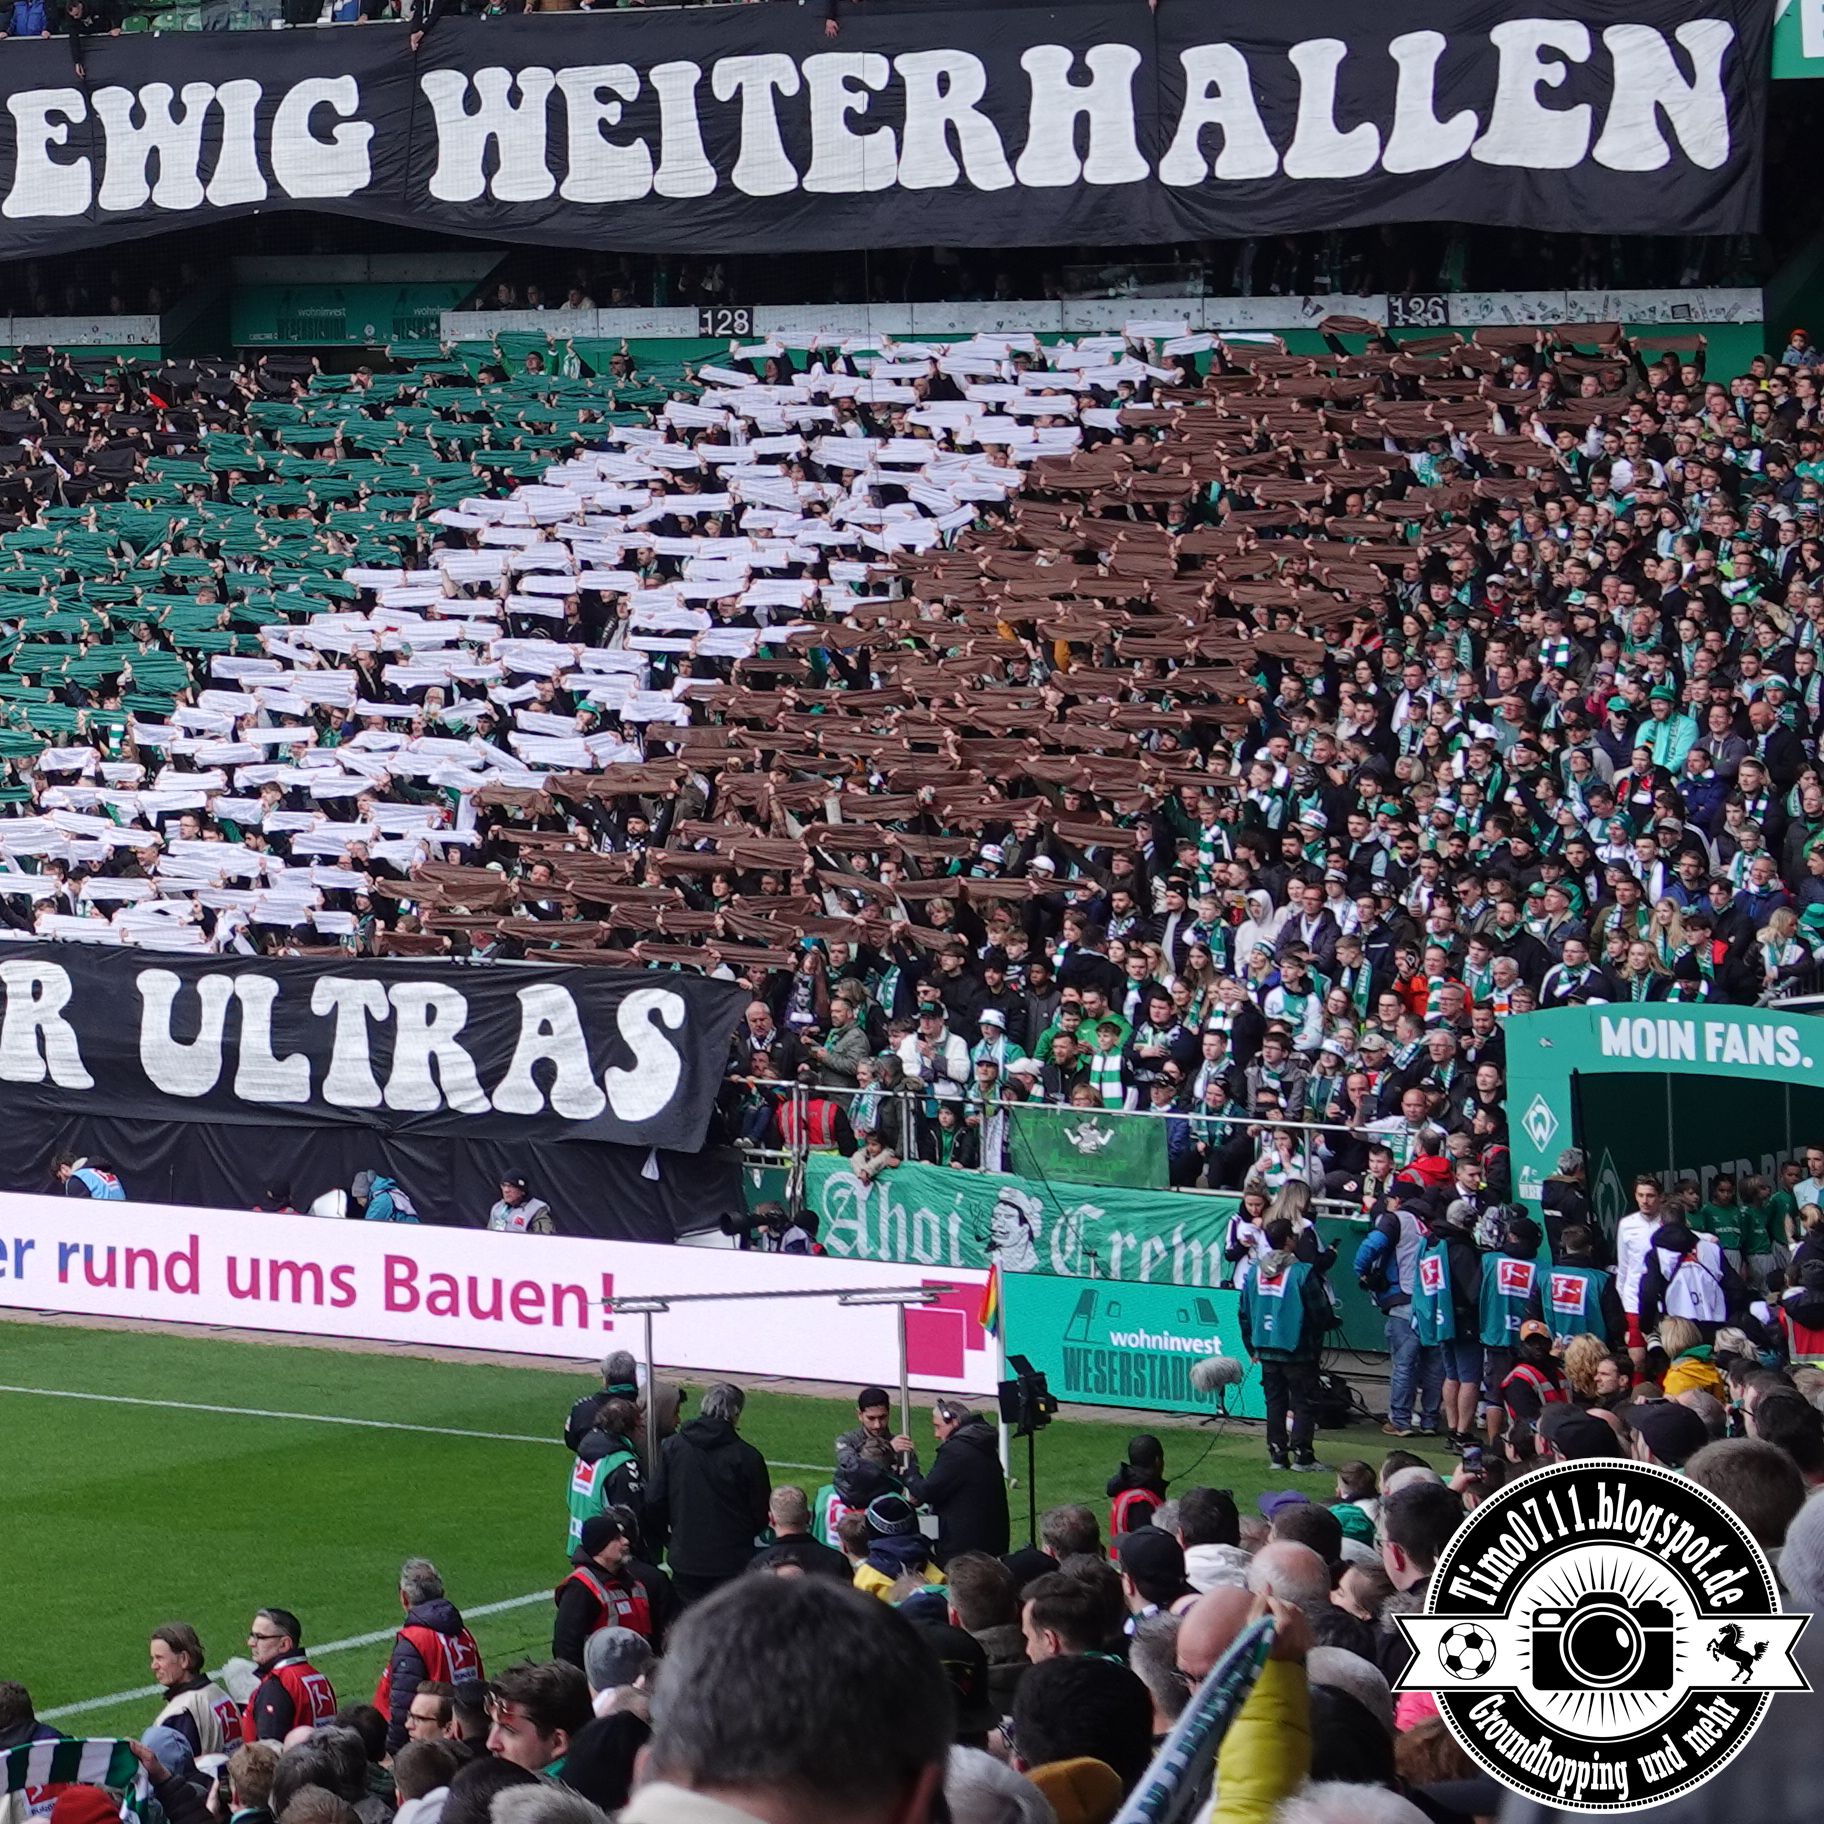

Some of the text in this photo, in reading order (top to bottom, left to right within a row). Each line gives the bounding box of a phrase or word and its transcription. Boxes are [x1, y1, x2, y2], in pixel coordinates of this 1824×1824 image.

[1, 73, 375, 219] EWIG
[421, 17, 1734, 204] WEITERHALLEN
[298, 306, 346, 318] wohninvest
[702, 308, 749, 336] 128
[135, 968, 686, 1122] ULTRAS
[1601, 1016, 1814, 1069] MOIN FANS.
[57, 1232, 201, 1296] rund
[228, 1254, 358, 1308] ums
[383, 1254, 615, 1332] Bauen!
[1110, 1328, 1222, 1356] wohninvest
